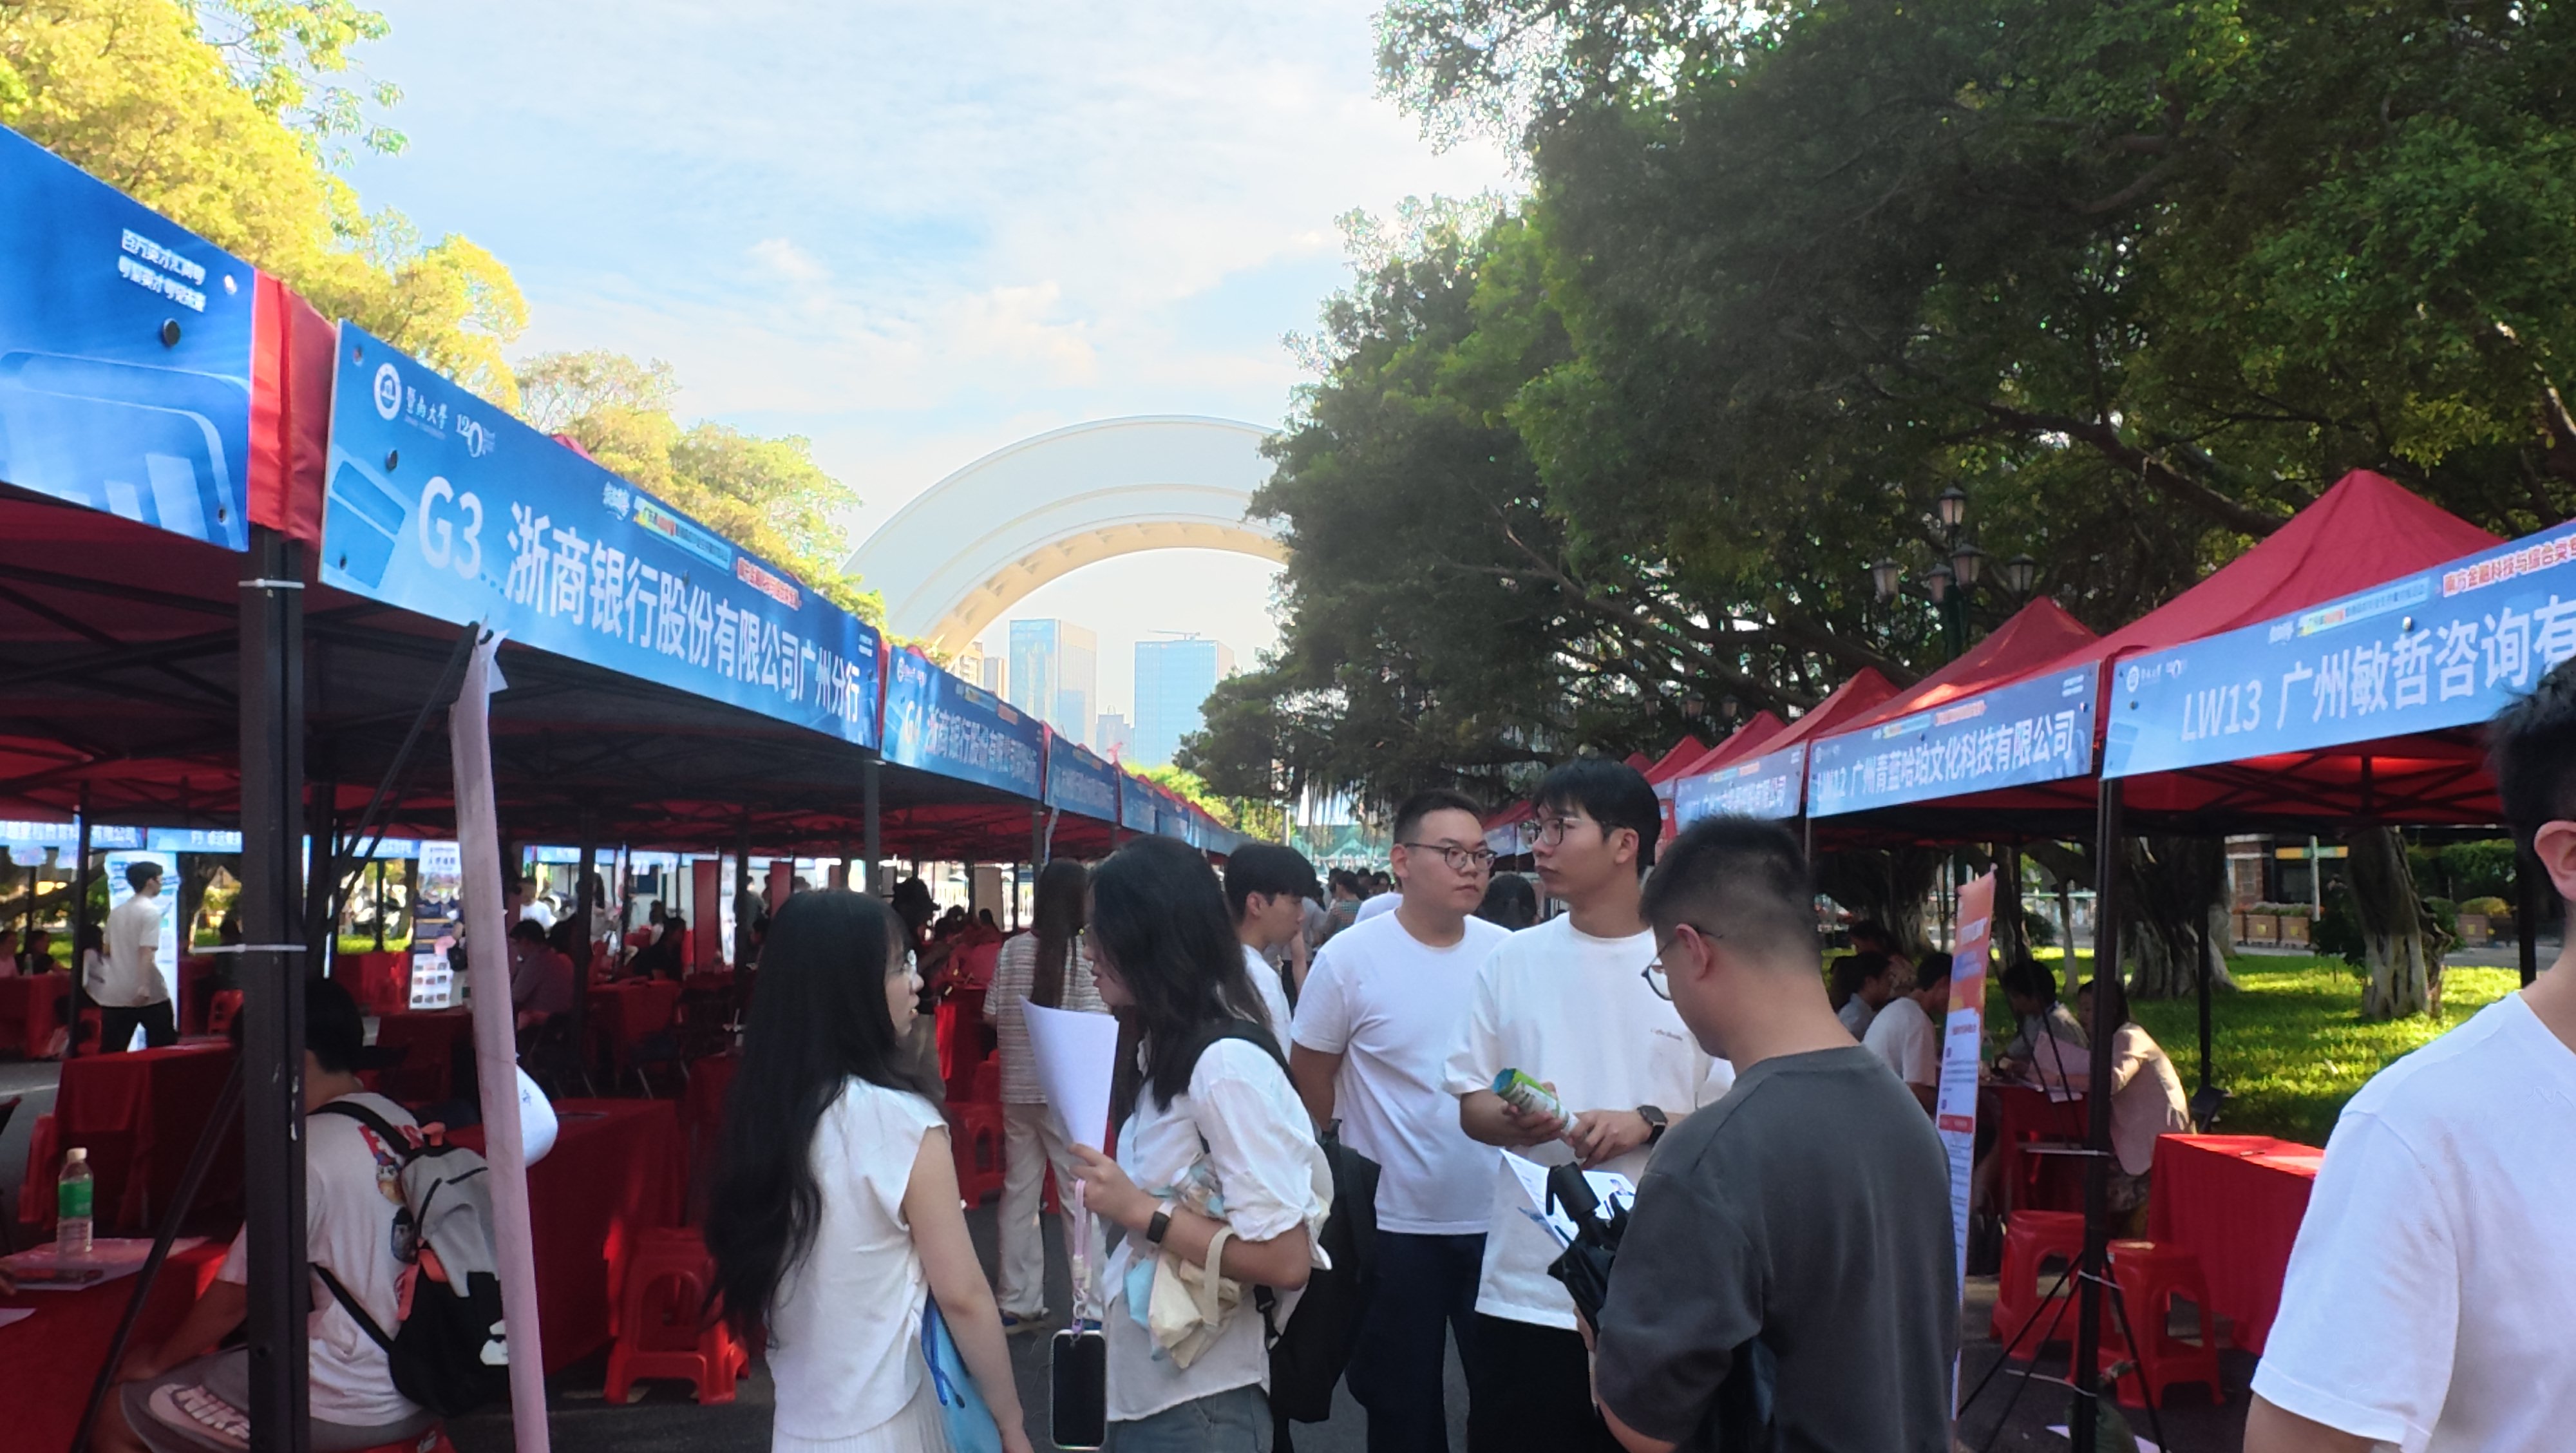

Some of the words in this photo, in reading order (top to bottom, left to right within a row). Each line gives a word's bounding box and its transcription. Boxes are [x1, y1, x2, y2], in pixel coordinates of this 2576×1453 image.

[419, 476, 483, 580] G3
[505, 501, 860, 723] 浙商银行股份有限公司广州分行
[2181, 679, 2262, 743] LW13
[2277, 594, 2576, 731] 广州敏哲咨询有
